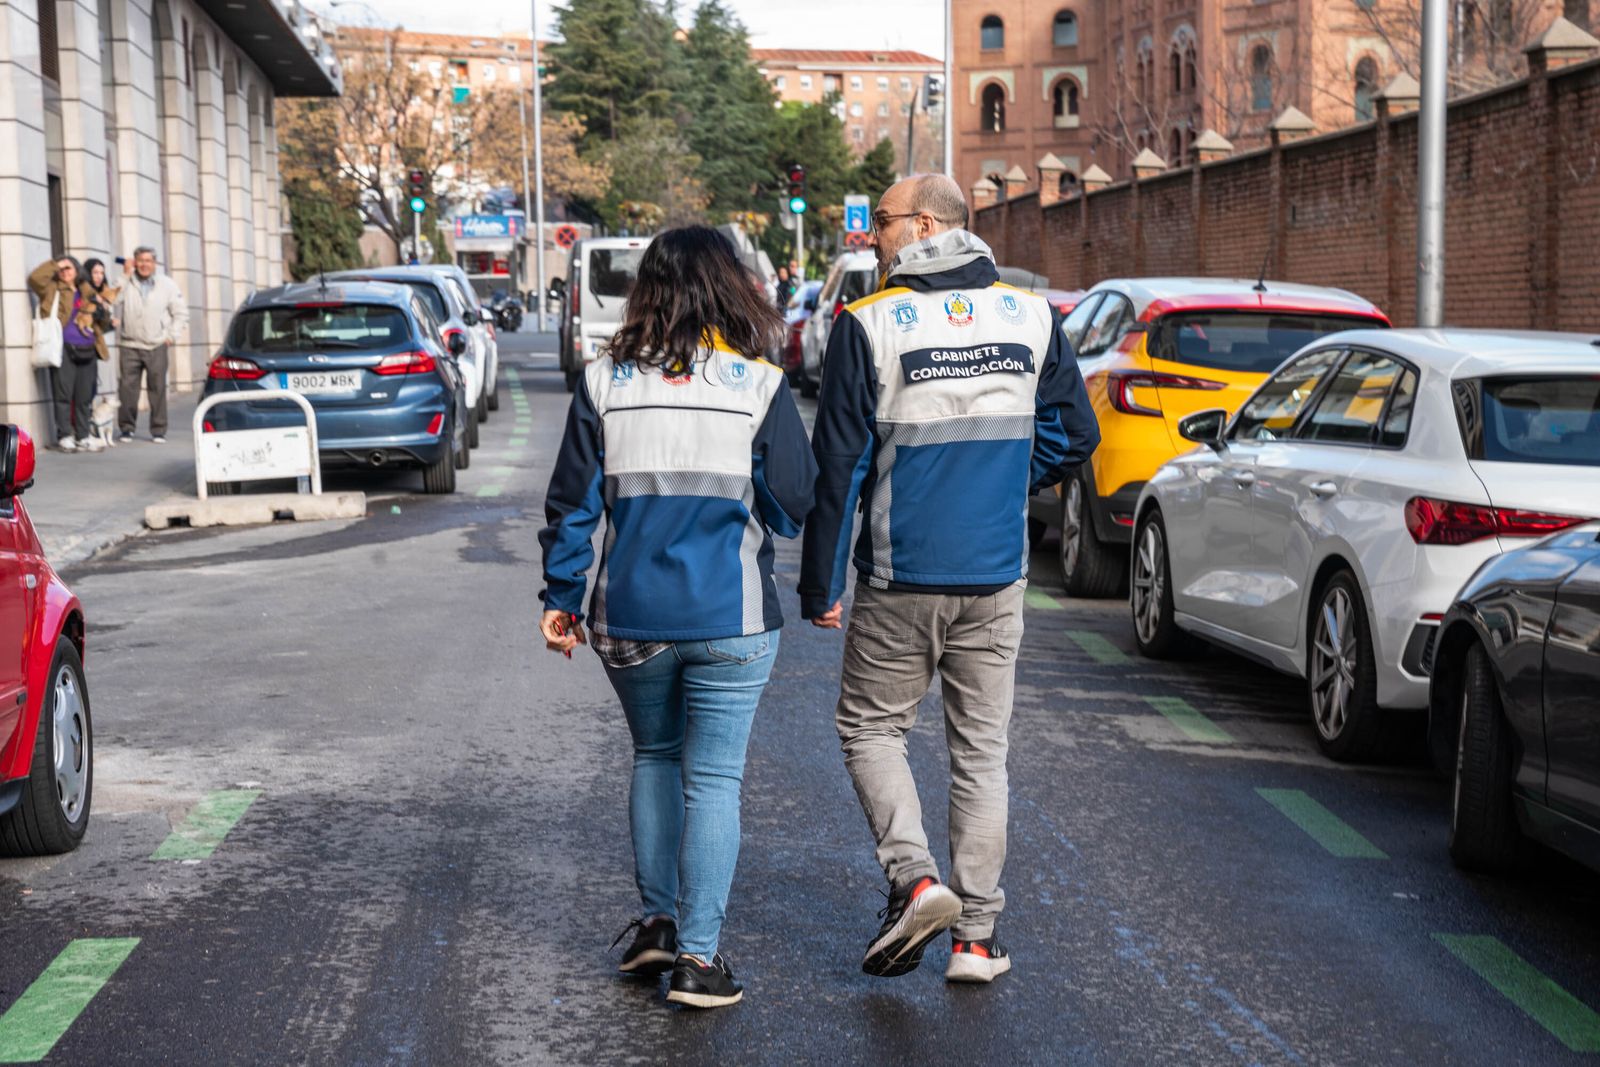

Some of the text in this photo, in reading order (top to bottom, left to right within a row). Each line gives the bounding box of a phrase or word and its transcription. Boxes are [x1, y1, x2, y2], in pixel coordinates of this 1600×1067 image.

[930, 346, 1000, 362] GABINETE
[910, 357, 1024, 381] COMUNICACIÓN
[293, 375, 326, 388] 9002
